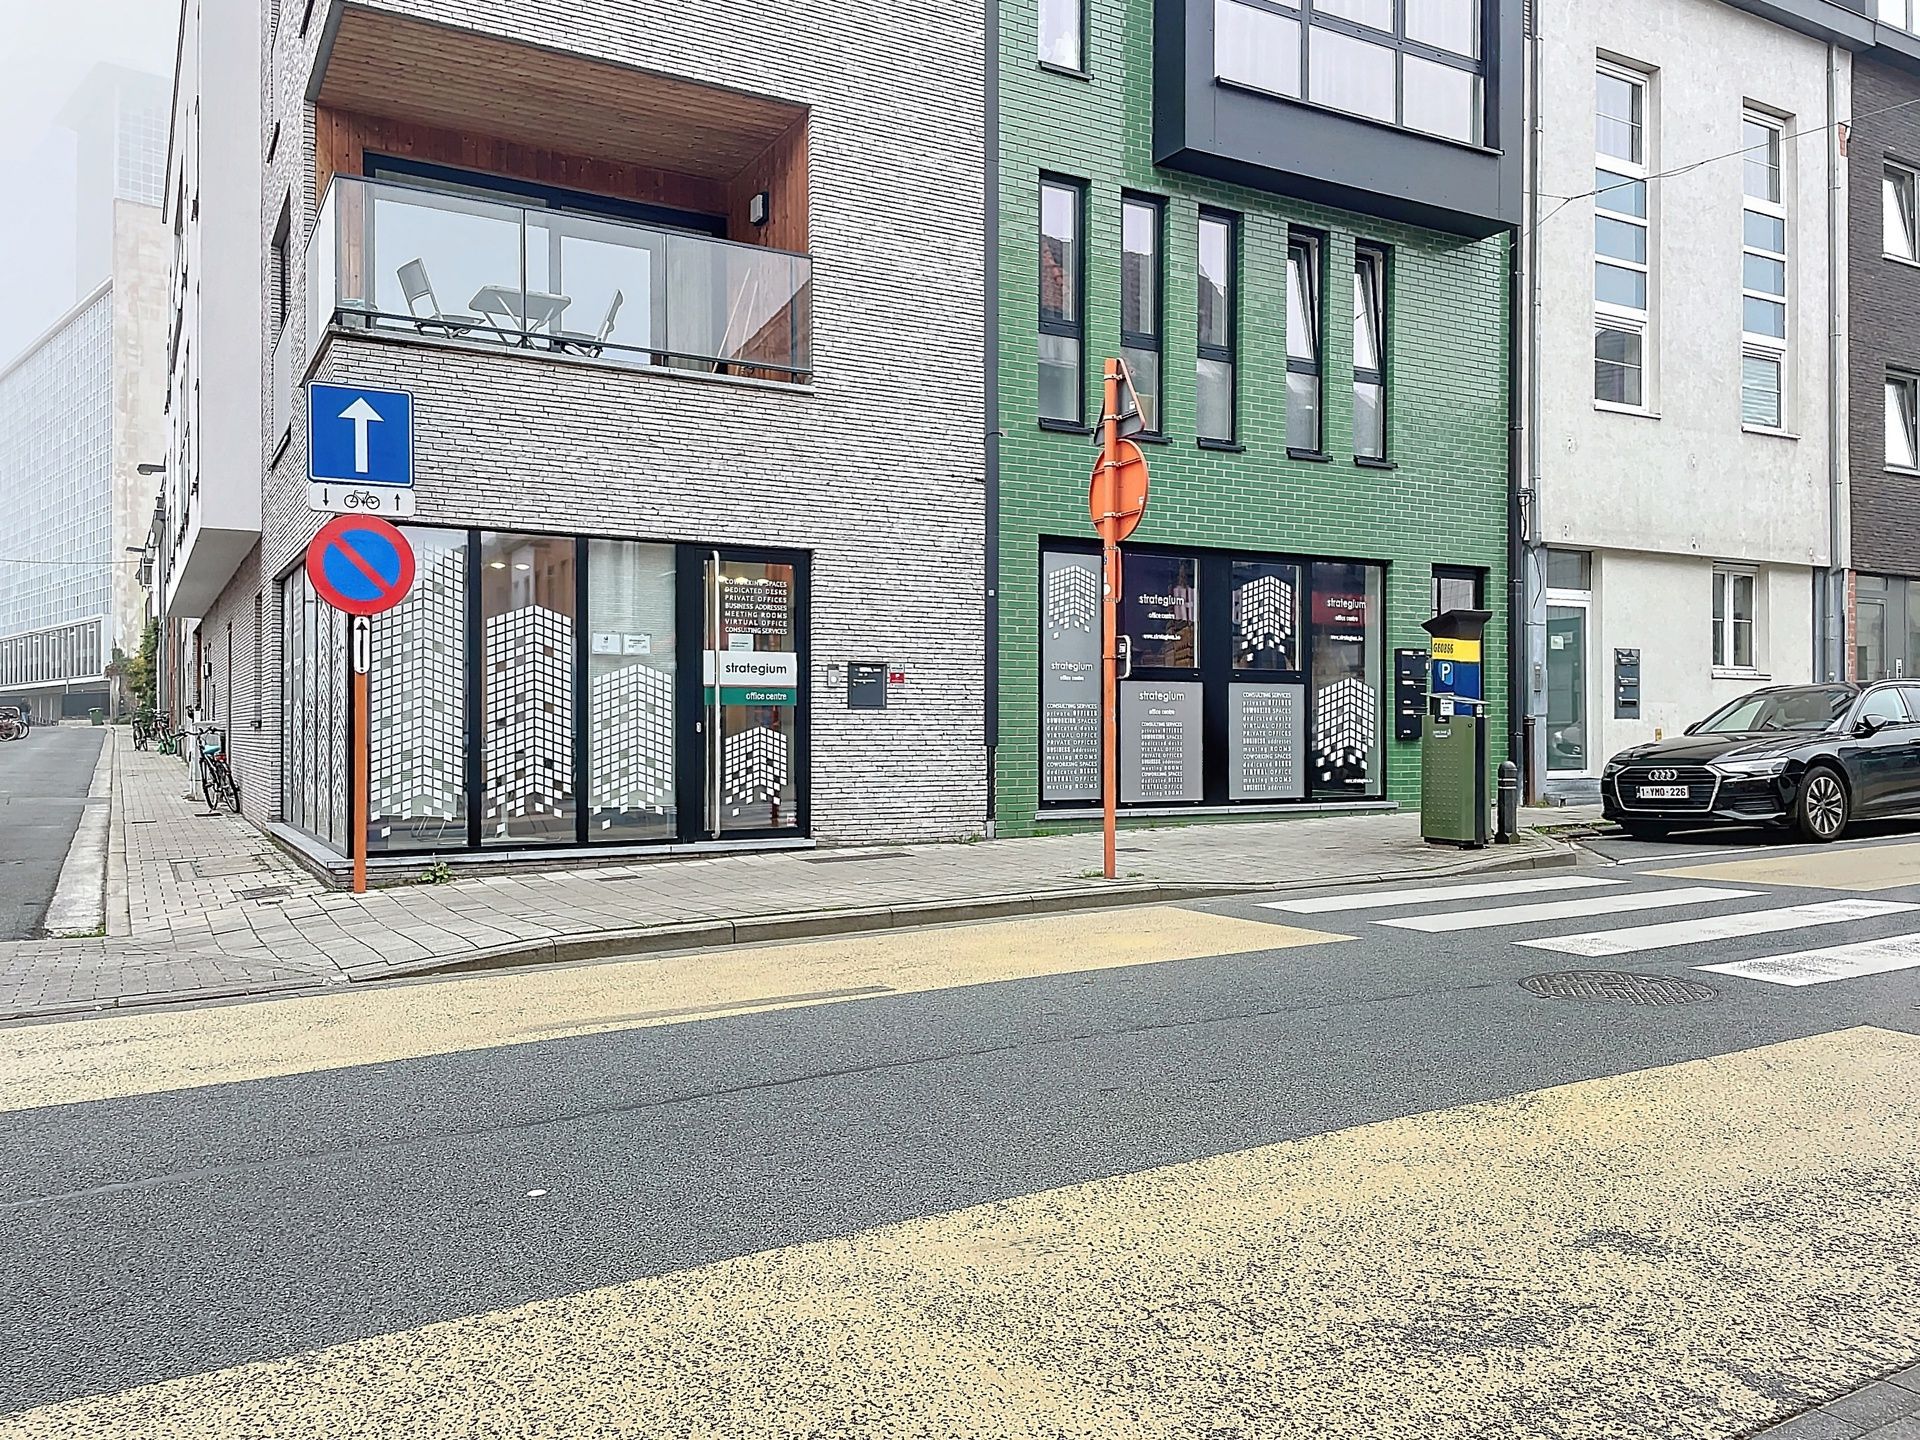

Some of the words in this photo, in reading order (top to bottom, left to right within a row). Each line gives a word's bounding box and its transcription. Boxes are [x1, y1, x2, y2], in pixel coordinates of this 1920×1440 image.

[1139, 594, 1184, 606] strategium
[1327, 598, 1366, 610] strategium
[726, 662, 787, 676] strategium
[1051, 662, 1092, 672] strategium
[1442, 663, 1450, 681] P
[1139, 690, 1184, 702] strategium
